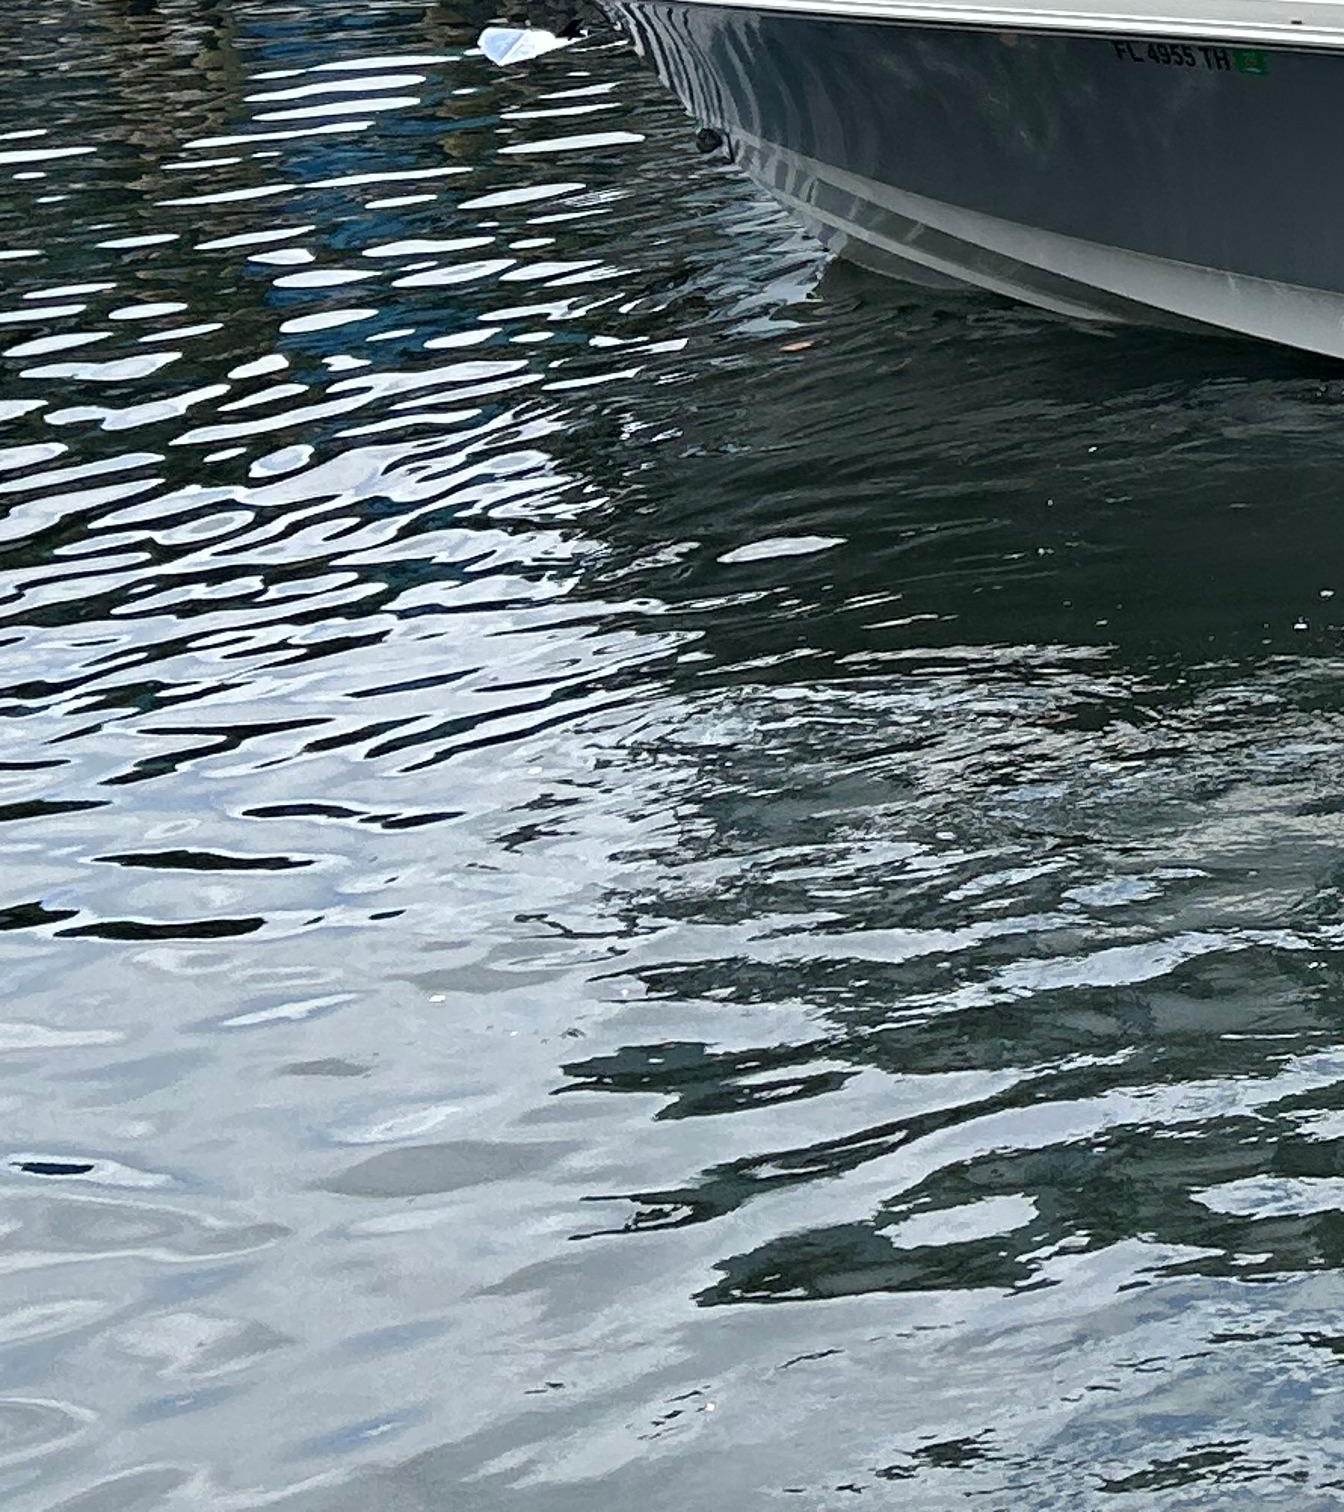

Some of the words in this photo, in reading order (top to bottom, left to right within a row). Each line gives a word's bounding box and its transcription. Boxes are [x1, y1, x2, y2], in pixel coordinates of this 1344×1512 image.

[1111, 39, 1145, 63] FL
[1147, 43, 1197, 68] 4955
[1200, 47, 1231, 71] TH
